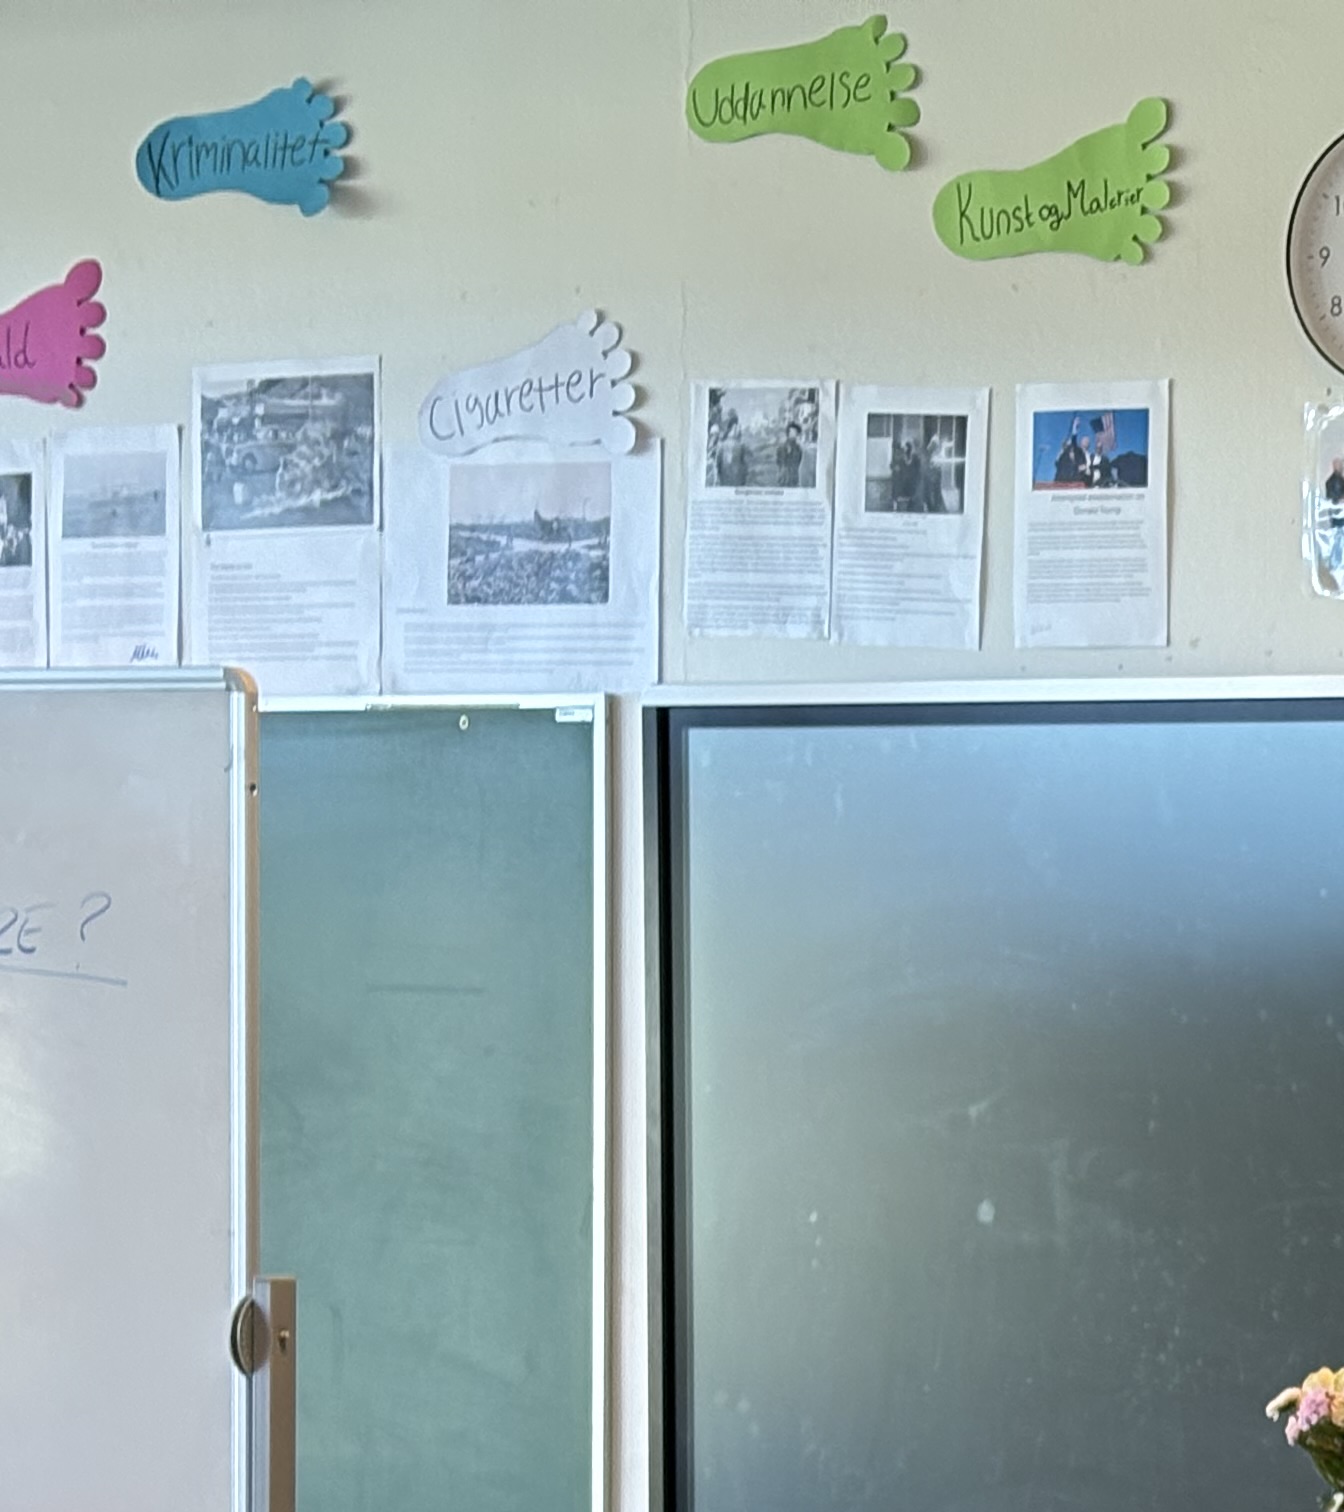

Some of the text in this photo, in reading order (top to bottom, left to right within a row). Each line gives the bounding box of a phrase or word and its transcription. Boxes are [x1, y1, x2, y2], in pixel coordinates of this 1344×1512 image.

[693, 70, 872, 128] Uddannelse
[147, 129, 328, 196] Kriminalitet
[956, 181, 1034, 246] Kunst
[1037, 202, 1066, 232] og
[1319, 245, 1331, 268] 9
[1330, 295, 1343, 318] 8
[428, 366, 607, 442] Cigaretter
